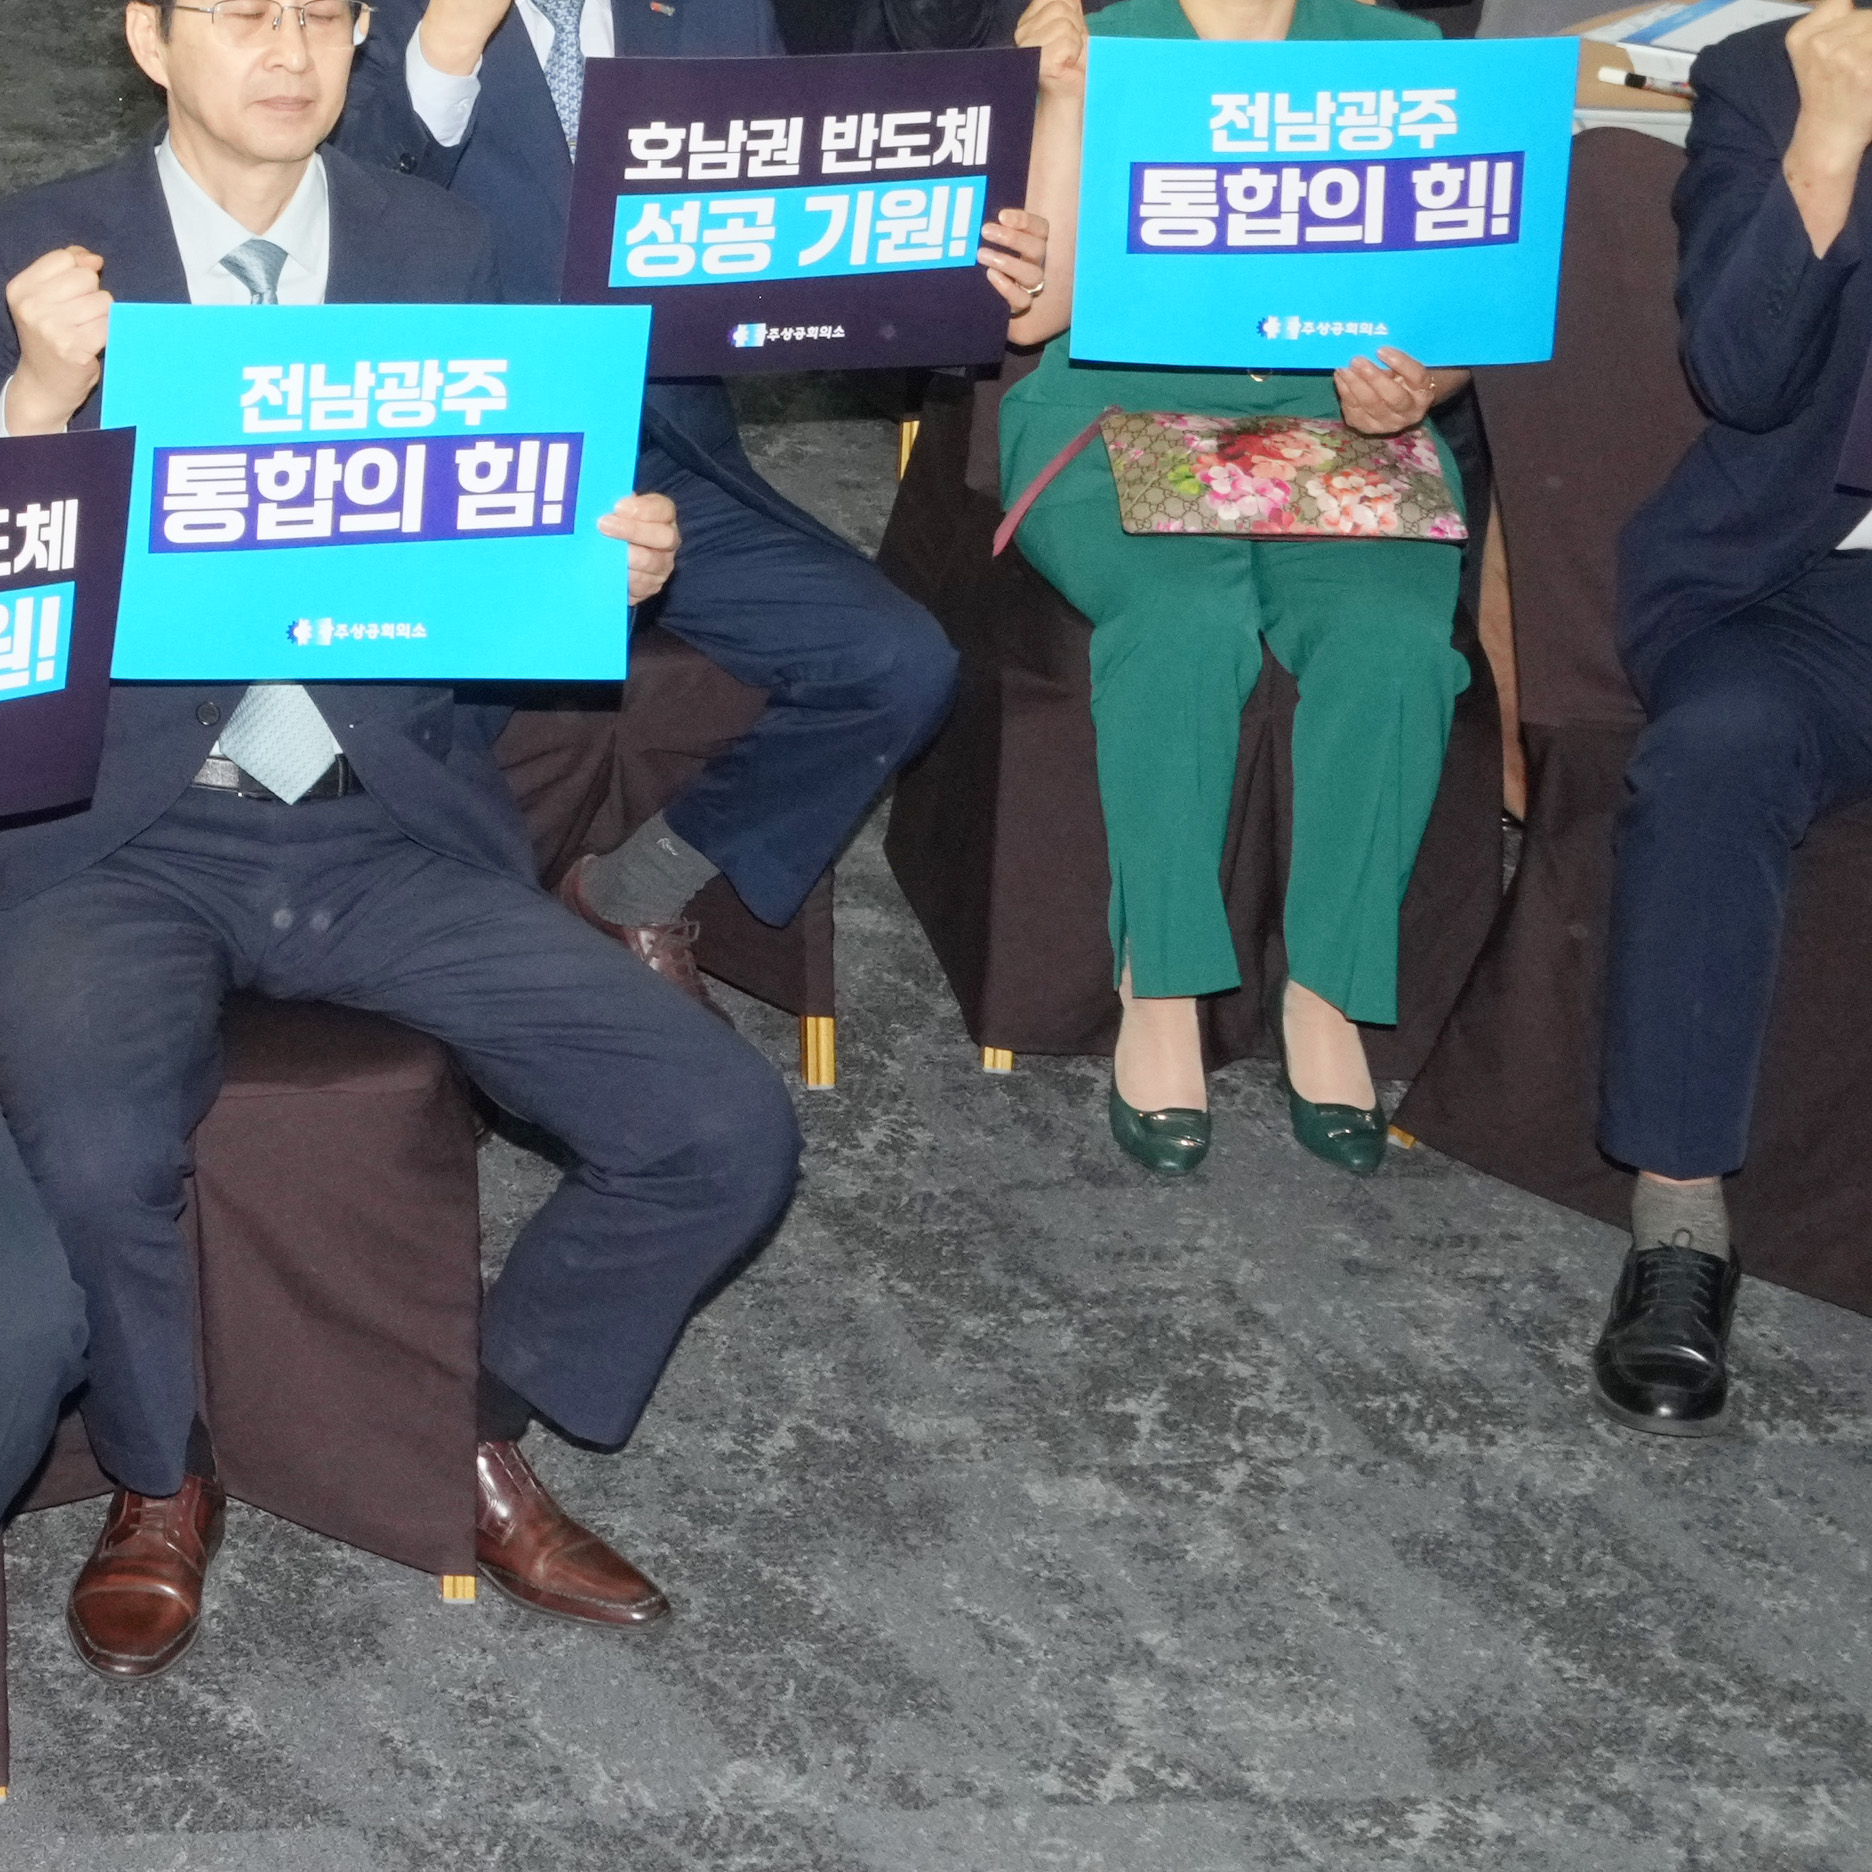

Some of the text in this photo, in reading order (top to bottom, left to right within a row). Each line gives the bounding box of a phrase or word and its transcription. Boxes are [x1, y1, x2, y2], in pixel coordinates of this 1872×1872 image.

[624, 105, 991, 180] 호남권 반도체
[1209, 88, 1455, 153] 전남광주
[625, 185, 975, 278] 성공 기원!
[1139, 160, 1513, 247] 통합의 힘!
[240, 359, 508, 434] 전남광주
[163, 440, 570, 544] 통합의 힘!
